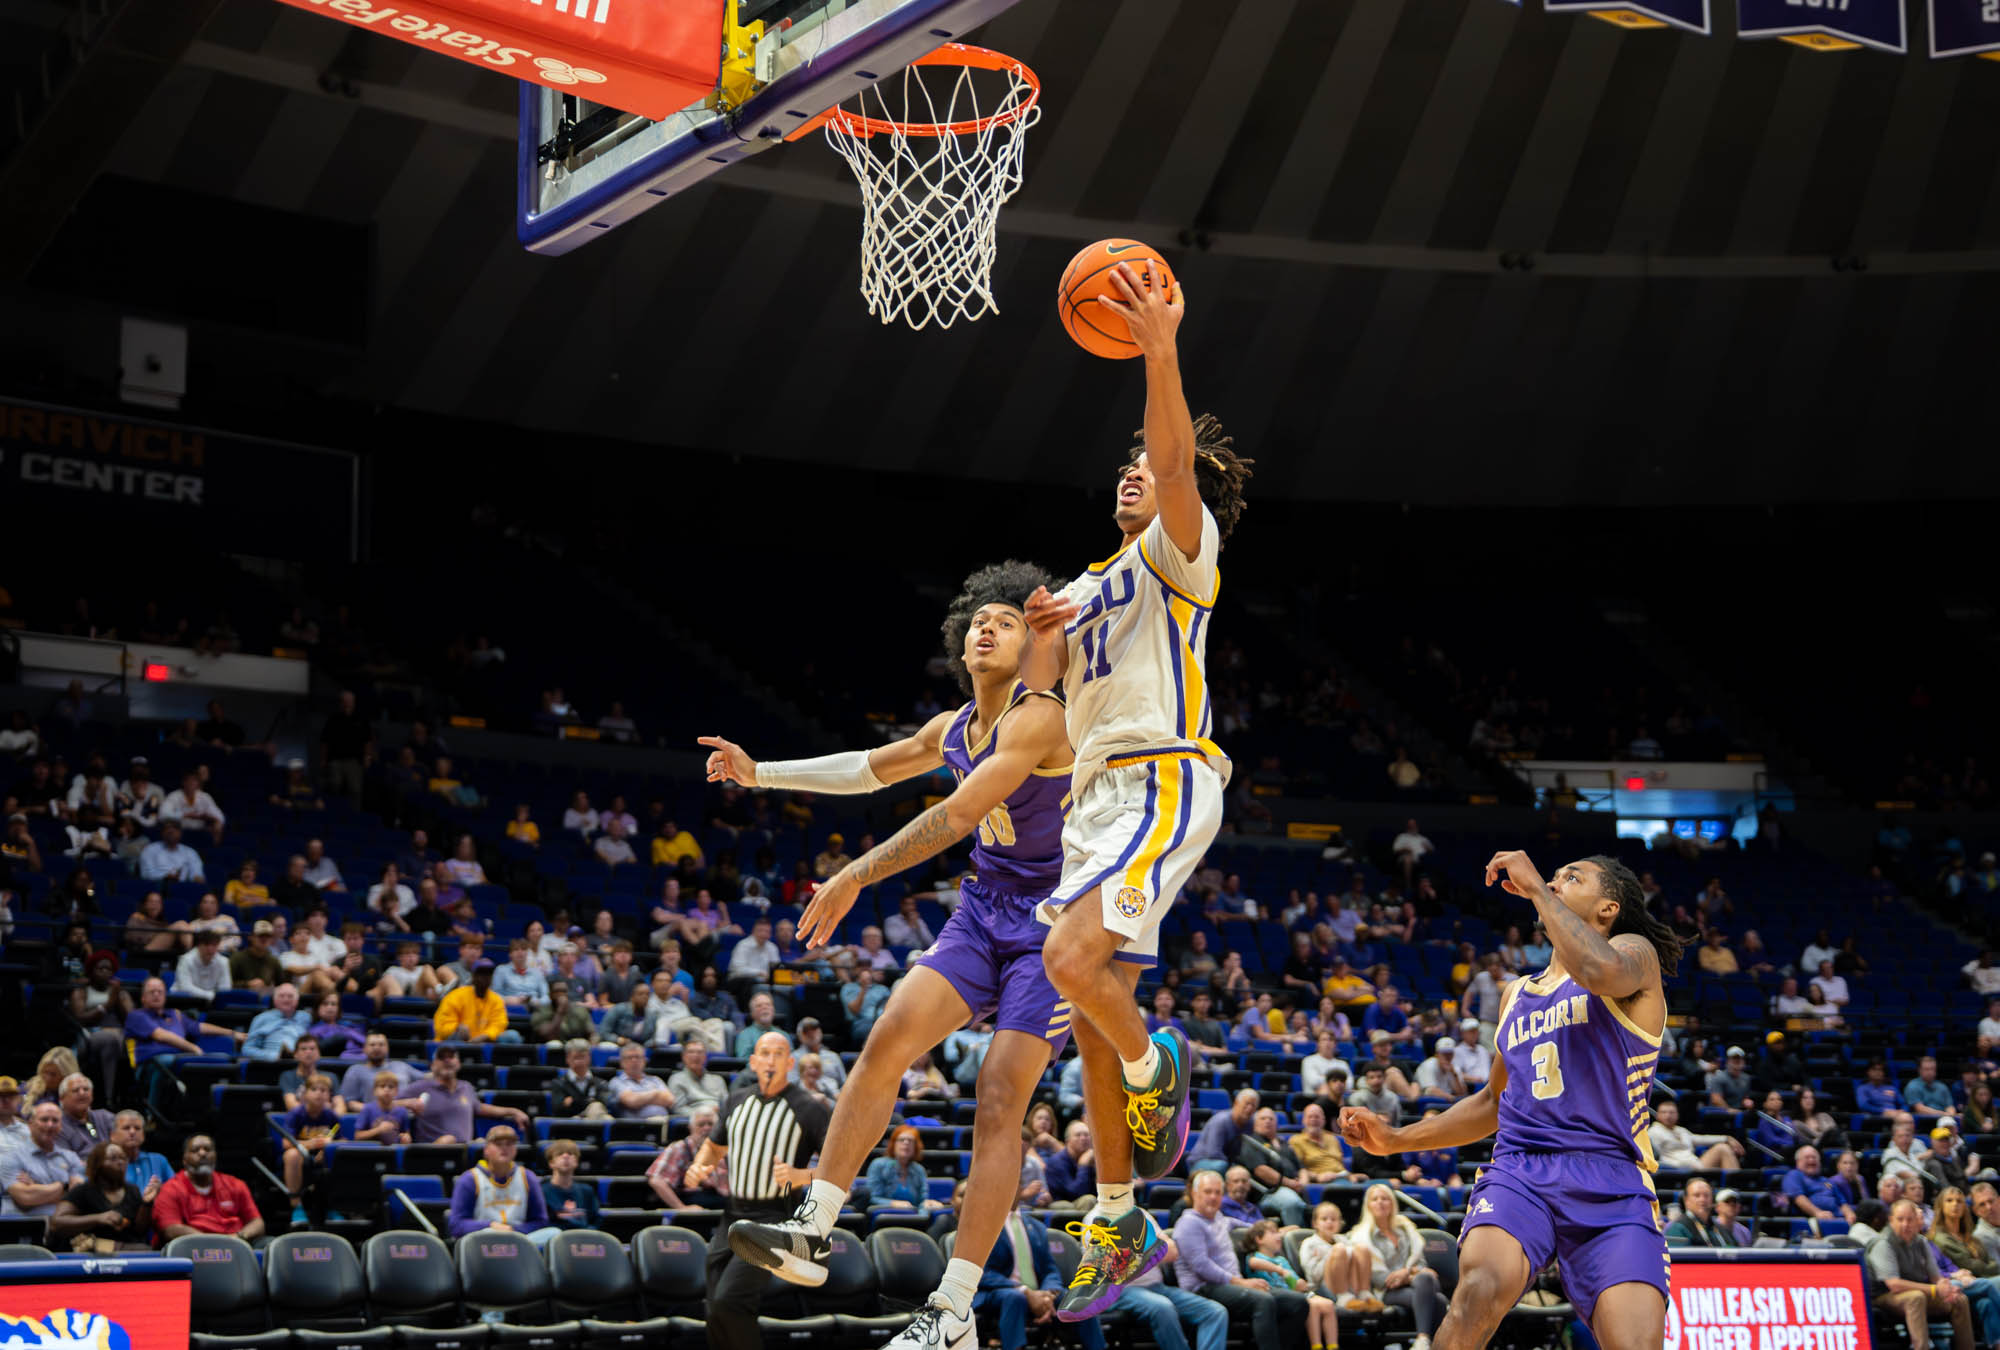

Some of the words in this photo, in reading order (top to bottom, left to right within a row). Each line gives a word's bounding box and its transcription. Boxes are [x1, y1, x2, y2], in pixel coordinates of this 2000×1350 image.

[0, 403, 206, 468] RAVICH
[20, 451, 206, 505] CENTER
[1081, 619, 1112, 684] 11
[1507, 994, 1588, 1052] ALCORN
[1531, 1041, 1565, 1101] 3
[1680, 1287, 1788, 1325] UNLEASH
[1789, 1286, 1856, 1324] YOUR
[1684, 1325, 1753, 1350] TIGER
[1759, 1325, 1858, 1350] APPETITE
